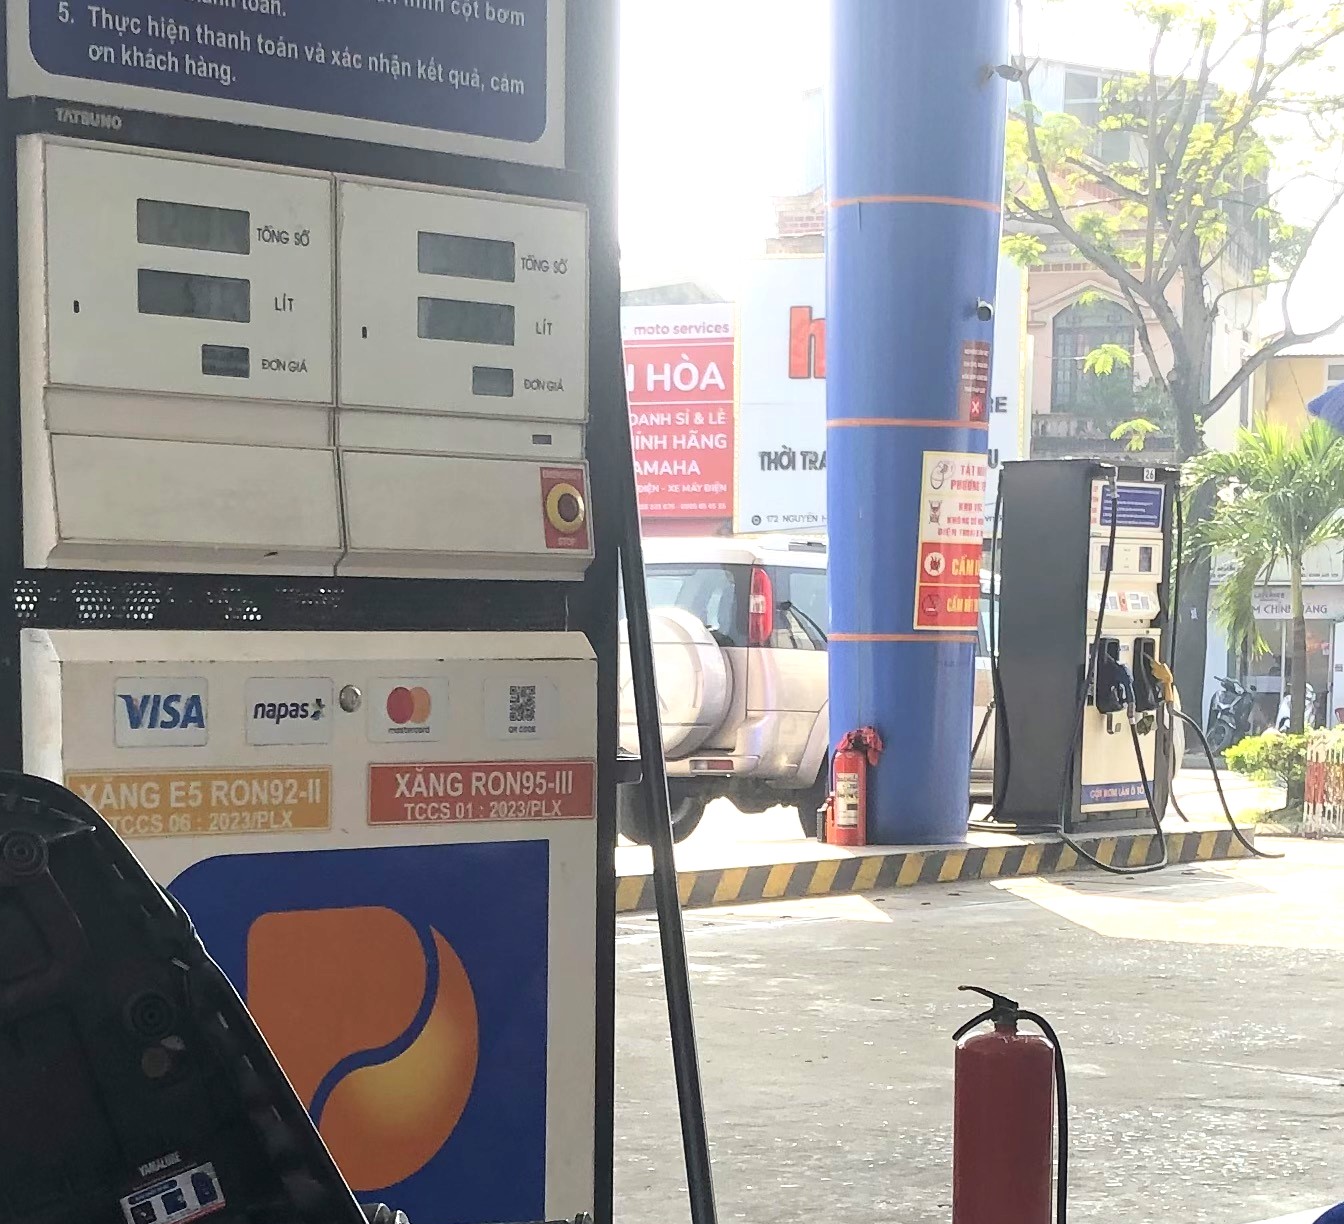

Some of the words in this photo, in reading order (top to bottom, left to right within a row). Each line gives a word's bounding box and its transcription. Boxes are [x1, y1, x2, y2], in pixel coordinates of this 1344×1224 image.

[485, 4, 525, 26] bơm
[58, 5, 74, 24] 5.
[88, 6, 141, 36] Thực
[148, 16, 189, 45] hiện
[196, 25, 250, 53] thanh
[257, 36, 299, 60] toán
[304, 43, 326, 65] và
[331, 46, 362, 70] xác
[368, 53, 412, 80] nhận
[417, 57, 444, 83] kết
[449, 68, 485, 92] quả,
[491, 74, 525, 95] cảm
[88, 44, 115, 63] ơn
[121, 43, 179, 73] khách
[185, 56, 236, 86] hàng.
[257, 227, 289, 245] TỔNG
[294, 228, 311, 247] SỐ
[521, 253, 549, 273] TỔNG
[274, 293, 294, 312] LÍT
[535, 319, 553, 336] LÍT
[634, 324, 670, 335] moto
[673, 321, 730, 335] services
[288, 358, 308, 374] GIÁ
[646, 352, 726, 392] HÒA
[694, 411, 705, 425] &
[672, 429, 728, 450] HÃNG
[1145, 469, 1155, 480] 26
[117, 694, 205, 729] VISA
[80, 776, 161, 811] XĂNG
[169, 781, 203, 808] E5
[211, 777, 322, 807] RON92-II
[395, 767, 464, 799] XĂNG
[471, 771, 573, 797] RON95-III
[404, 802, 451, 821] TCCS
[455, 802, 473, 819] 01
[489, 800, 562, 818] 2023/PLX
[113, 814, 163, 834] TCCS
[209, 809, 294, 832] 2023/PLX
